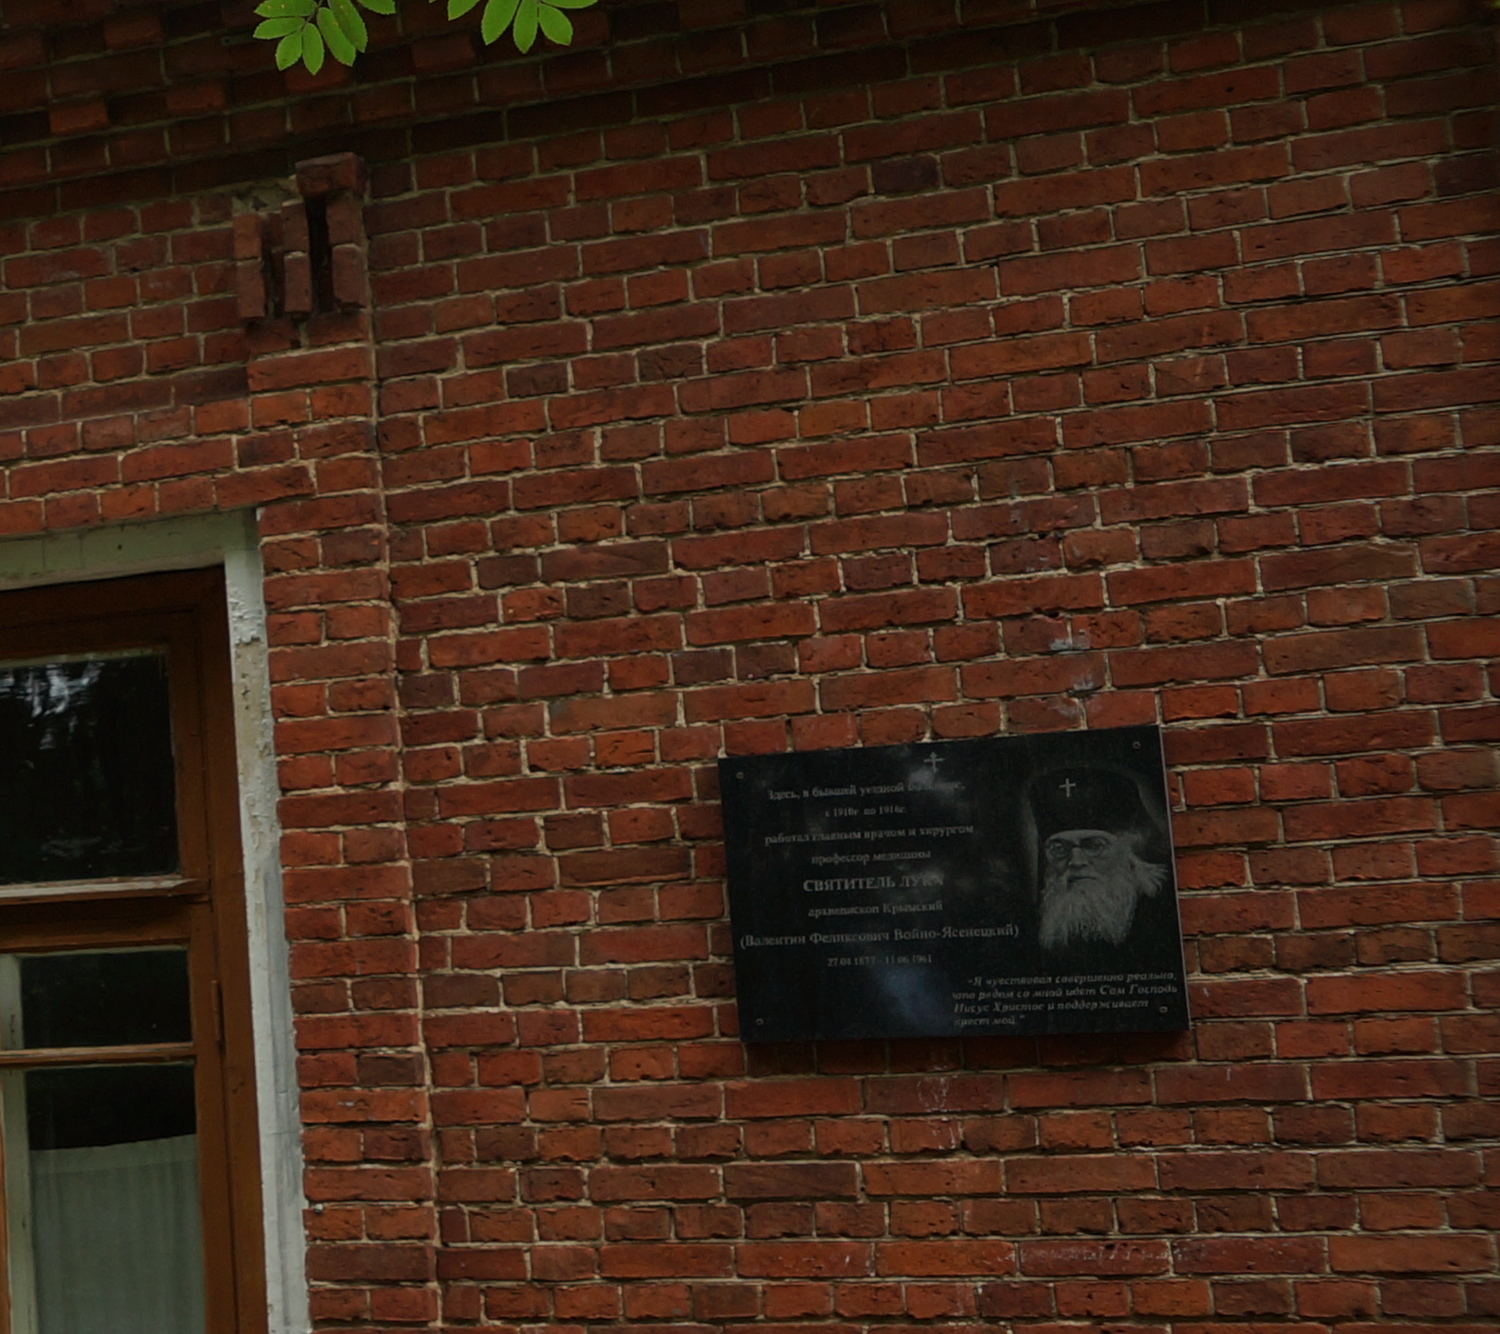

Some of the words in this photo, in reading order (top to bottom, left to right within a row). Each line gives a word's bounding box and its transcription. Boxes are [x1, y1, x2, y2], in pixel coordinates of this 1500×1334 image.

[803, 788, 809, 797] в
[812, 784, 857, 798] бывшей
[864, 808, 876, 816] по
[765, 831, 809, 846] работал
[812, 829, 861, 841] главным
[864, 828, 905, 842] врачом
[908, 827, 916, 836] и
[919, 824, 974, 838] хирургом
[811, 852, 869, 866] профессор
[872, 849, 931, 862] медицины
[803, 876, 895, 893] СВЯТИТЕЛЬ
[899, 873, 945, 888] ЛУКА
[808, 905, 879, 919] архиепископ
[883, 900, 943, 915] Крымский
[740, 933, 806, 950] (Валентин
[809, 929, 890, 946] Феликсович
[894, 923, 1019, 942] Войно-Ясенецкий)
[1055, 973, 1124, 986] совершенно
[952, 991, 975, 1000] что
[978, 988, 1014, 1001] рядом
[1016, 990, 1030, 998] со
[1032, 987, 1063, 997] мной
[1099, 984, 1126, 995] Сам
[1129, 982, 1178, 995] Господь
[992, 1001, 1045, 1013] Христос
[1047, 1001, 1055, 1011] и
[1057, 999, 1149, 1011] поддерживает
[953, 1016, 990, 1028] крест
